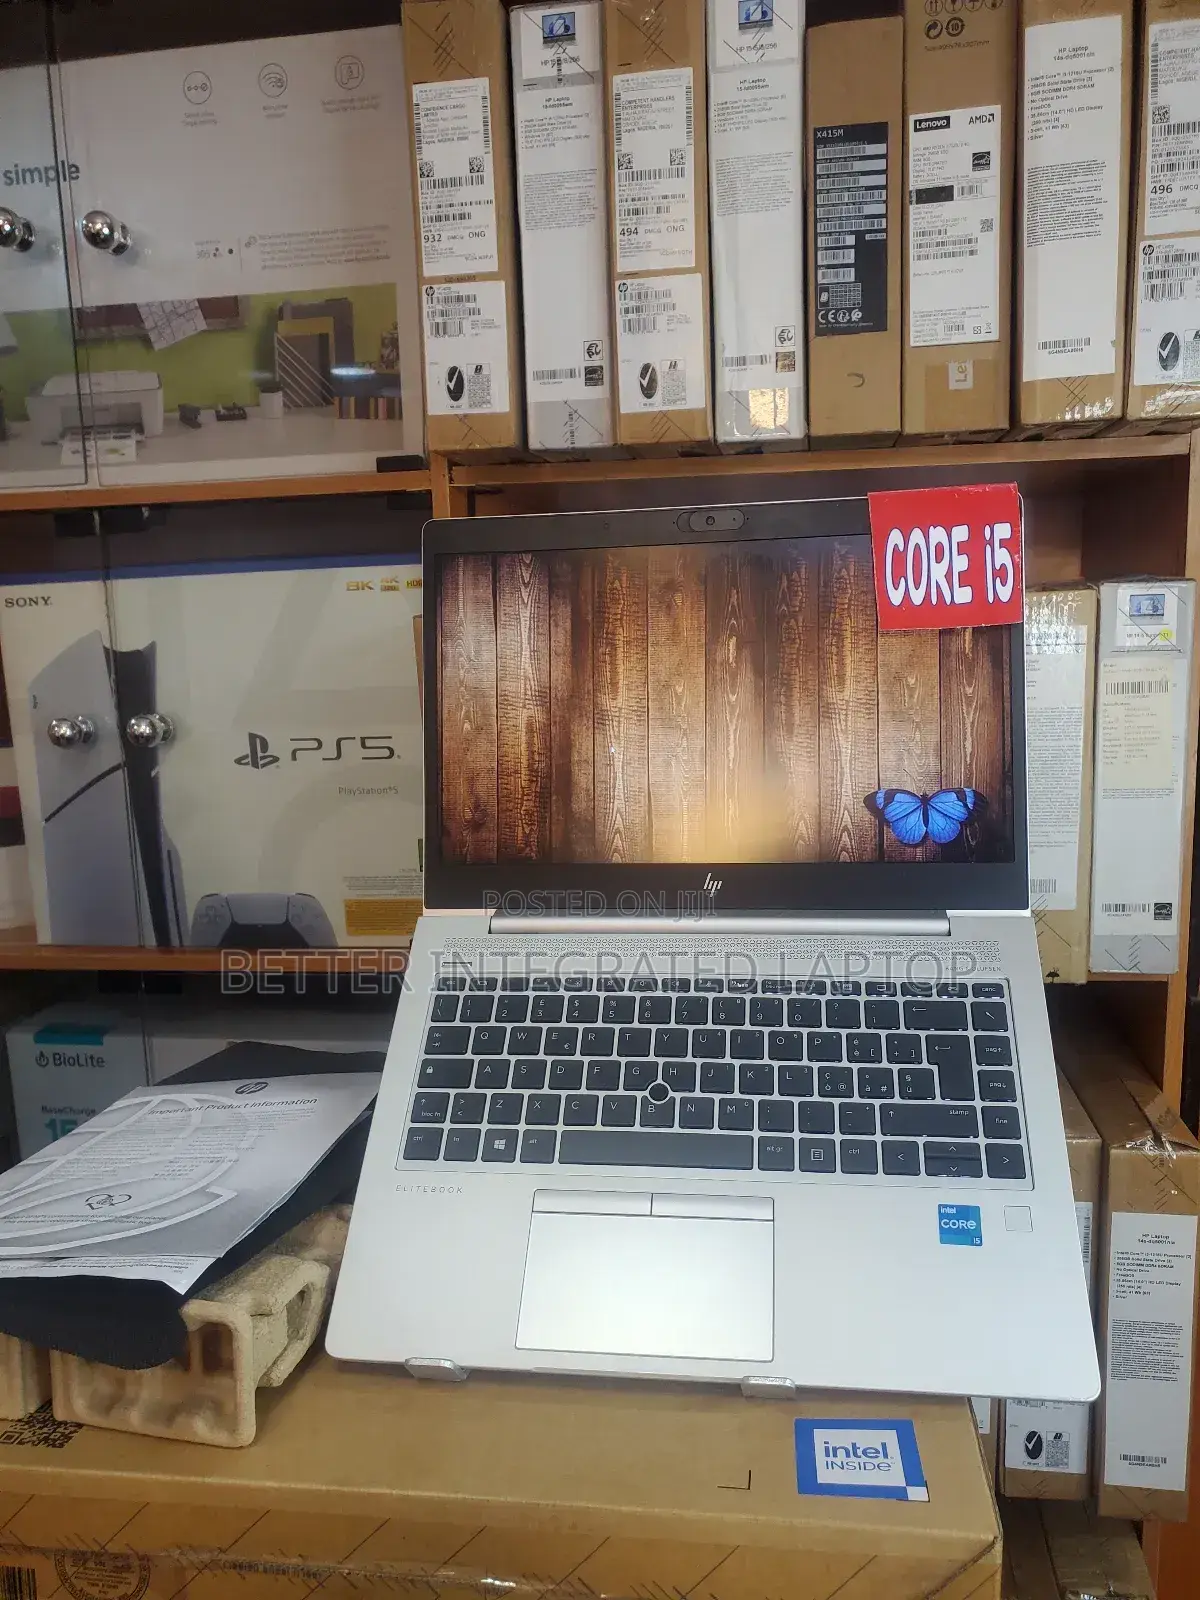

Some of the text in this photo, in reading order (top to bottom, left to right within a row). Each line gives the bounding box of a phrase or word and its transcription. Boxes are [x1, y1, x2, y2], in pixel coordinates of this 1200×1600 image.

[916, 115, 988, 129] Lenovo AMD
[816, 129, 844, 139] X415M
[3, 160, 81, 188] simple
[1151, 184, 1199, 195] 496 DMCQ
[424, 234, 442, 244] 932
[469, 231, 486, 239] ONG
[620, 227, 639, 237] 494
[666, 225, 685, 233] ONG
[885, 522, 1015, 607] CORE i5
[346, 581, 375, 591] 8K
[4, 596, 52, 608] SONY
[290, 735, 397, 762] PS5
[703, 872, 723, 897] hp
[719, 1012, 726, 1020] 8
[481, 1032, 489, 1040] Q
[588, 1033, 596, 1041] R
[662, 1034, 670, 1042] Y
[700, 1035, 707, 1043] U
[776, 1037, 785, 1045] O
[815, 1038, 822, 1046] P
[53, 1052, 106, 1068] BioLite
[484, 1066, 492, 1074] A
[520, 1066, 527, 1074] S
[557, 1066, 565, 1074] D
[594, 1067, 601, 1075] F
[633, 1067, 640, 1075] G
[670, 1068, 677, 1076] H
[747, 1071, 755, 1079] K
[786, 1072, 793, 1080] L
[837, 1083, 847, 1092] @
[880, 1085, 888, 1093] #
[42, 1105, 96, 1117] BaseCharge
[148, 1098, 318, 1115] Important Product Information
[496, 1100, 504, 1108] Z
[534, 1101, 542, 1109] X
[571, 1101, 579, 1110] C
[610, 1102, 618, 1110] V
[648, 1105, 656, 1113] B
[687, 1104, 695, 1112] N
[727, 1106, 736, 1114] M
[949, 1109, 969, 1117] stamp
[396, 1185, 464, 1194] ELITEBOOK
[940, 1206, 957, 1214] intel
[824, 1441, 889, 1460] intel
